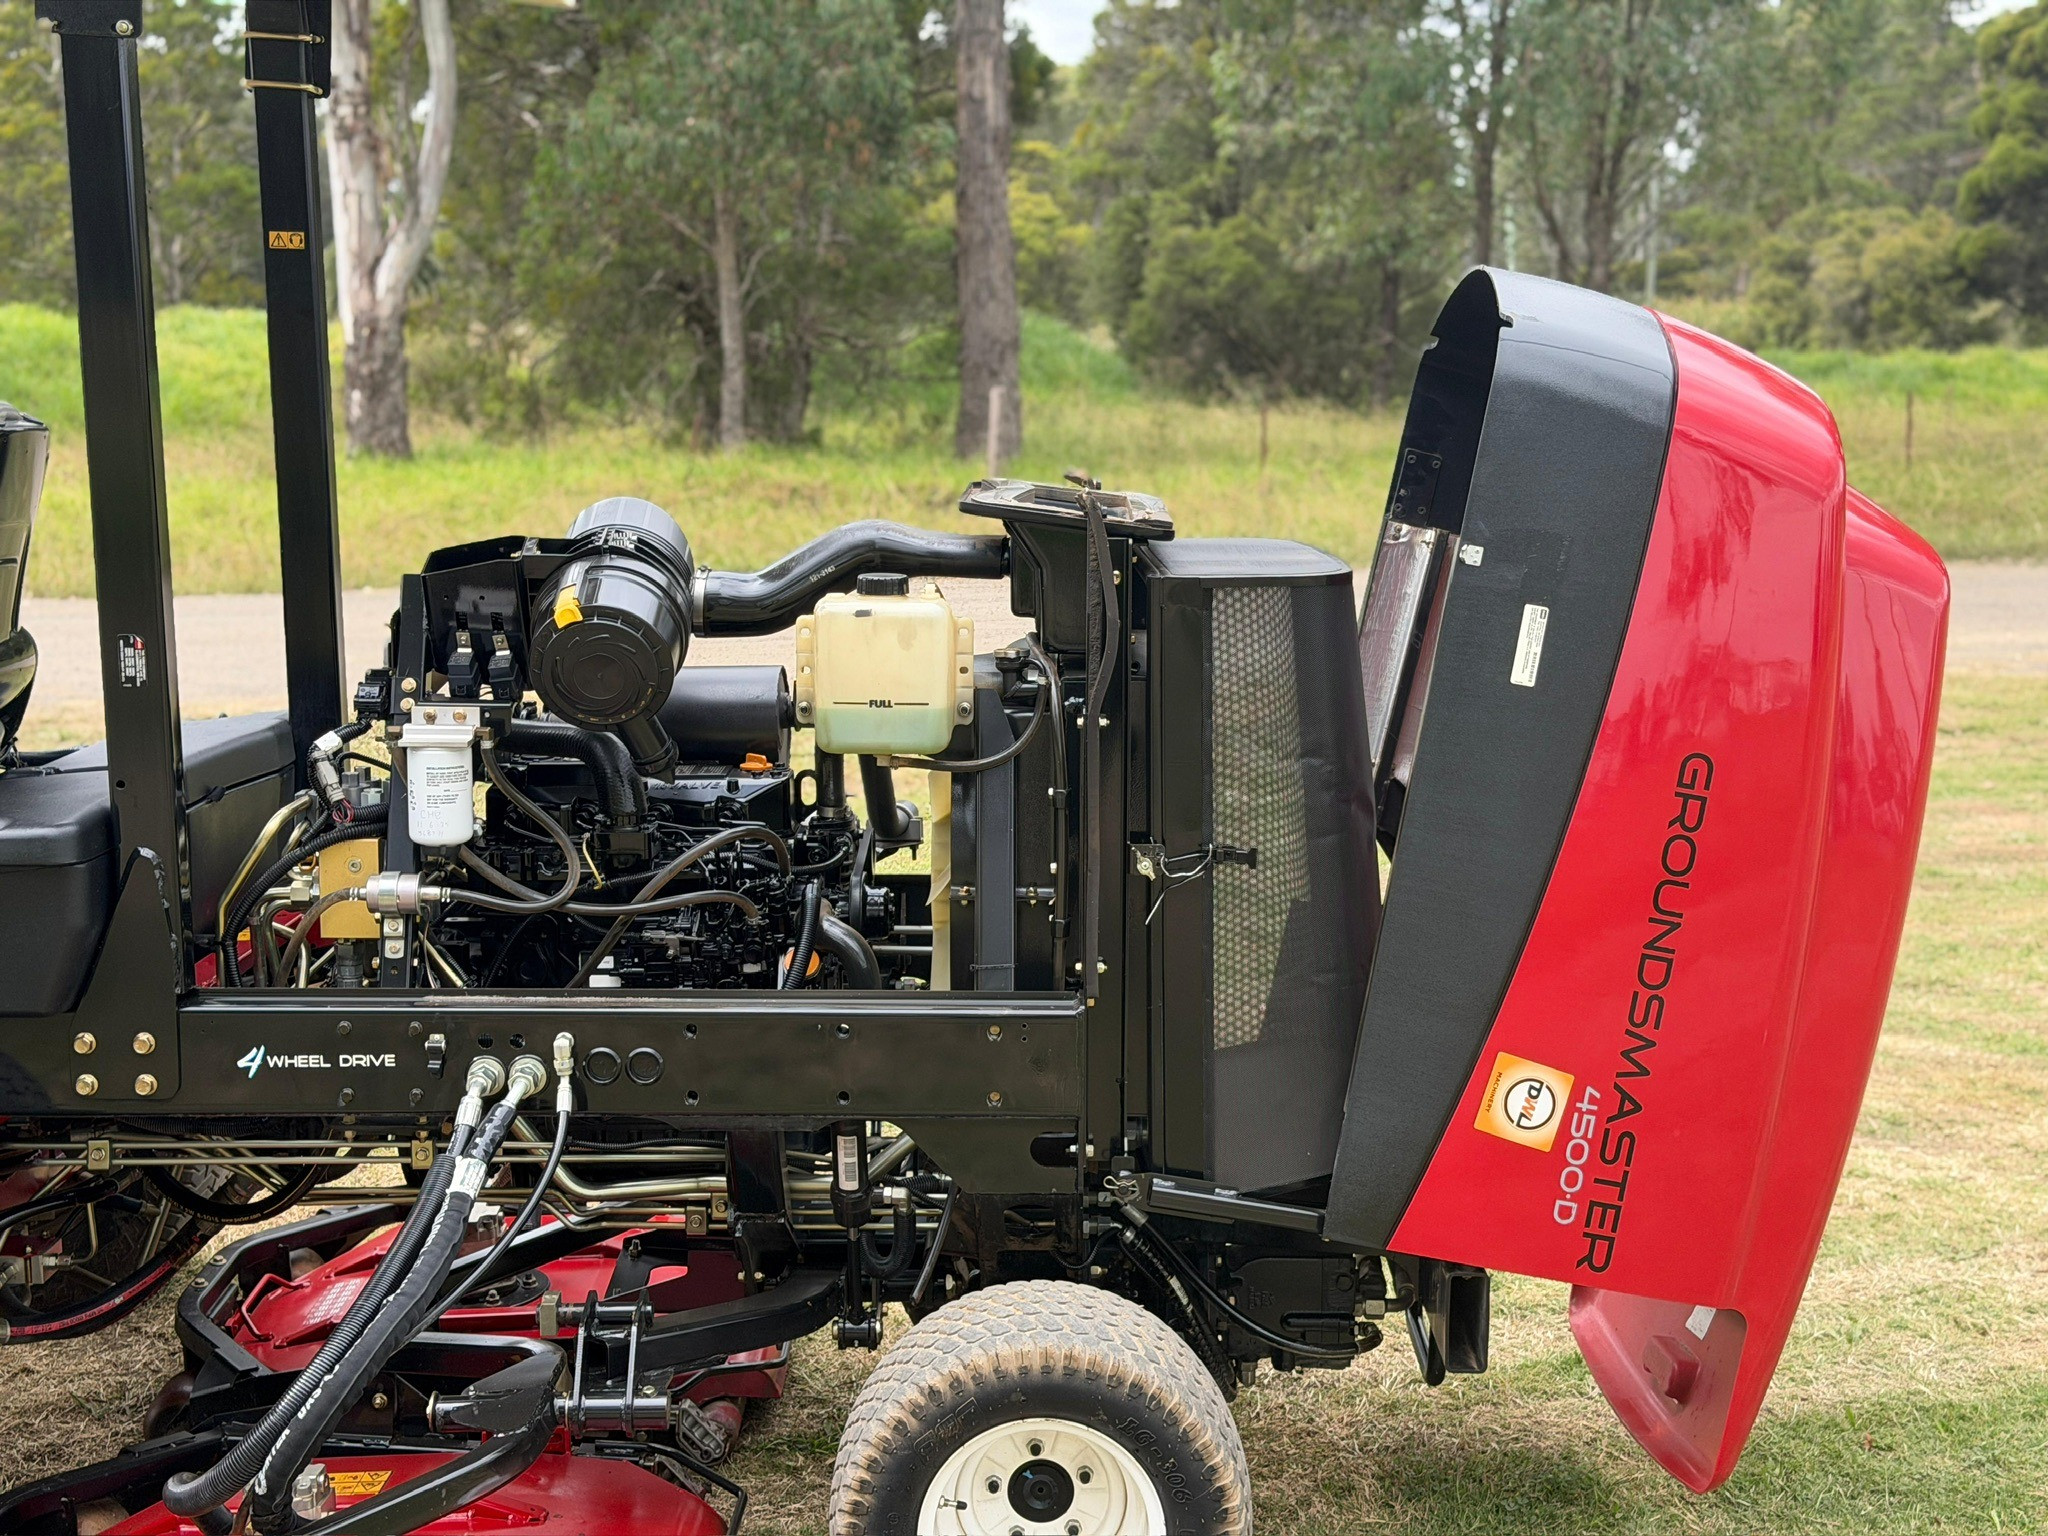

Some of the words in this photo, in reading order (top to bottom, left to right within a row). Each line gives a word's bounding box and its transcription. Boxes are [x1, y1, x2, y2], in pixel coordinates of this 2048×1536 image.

[869, 700, 893, 708] FULL
[1575, 752, 1714, 1273] GROUNDSMASTER
[236, 1045, 265, 1078] 4
[267, 1054, 331, 1067] WHEEL
[339, 1054, 396, 1067] DRIVE
[1485, 1072, 1502, 1113] MACHINERY
